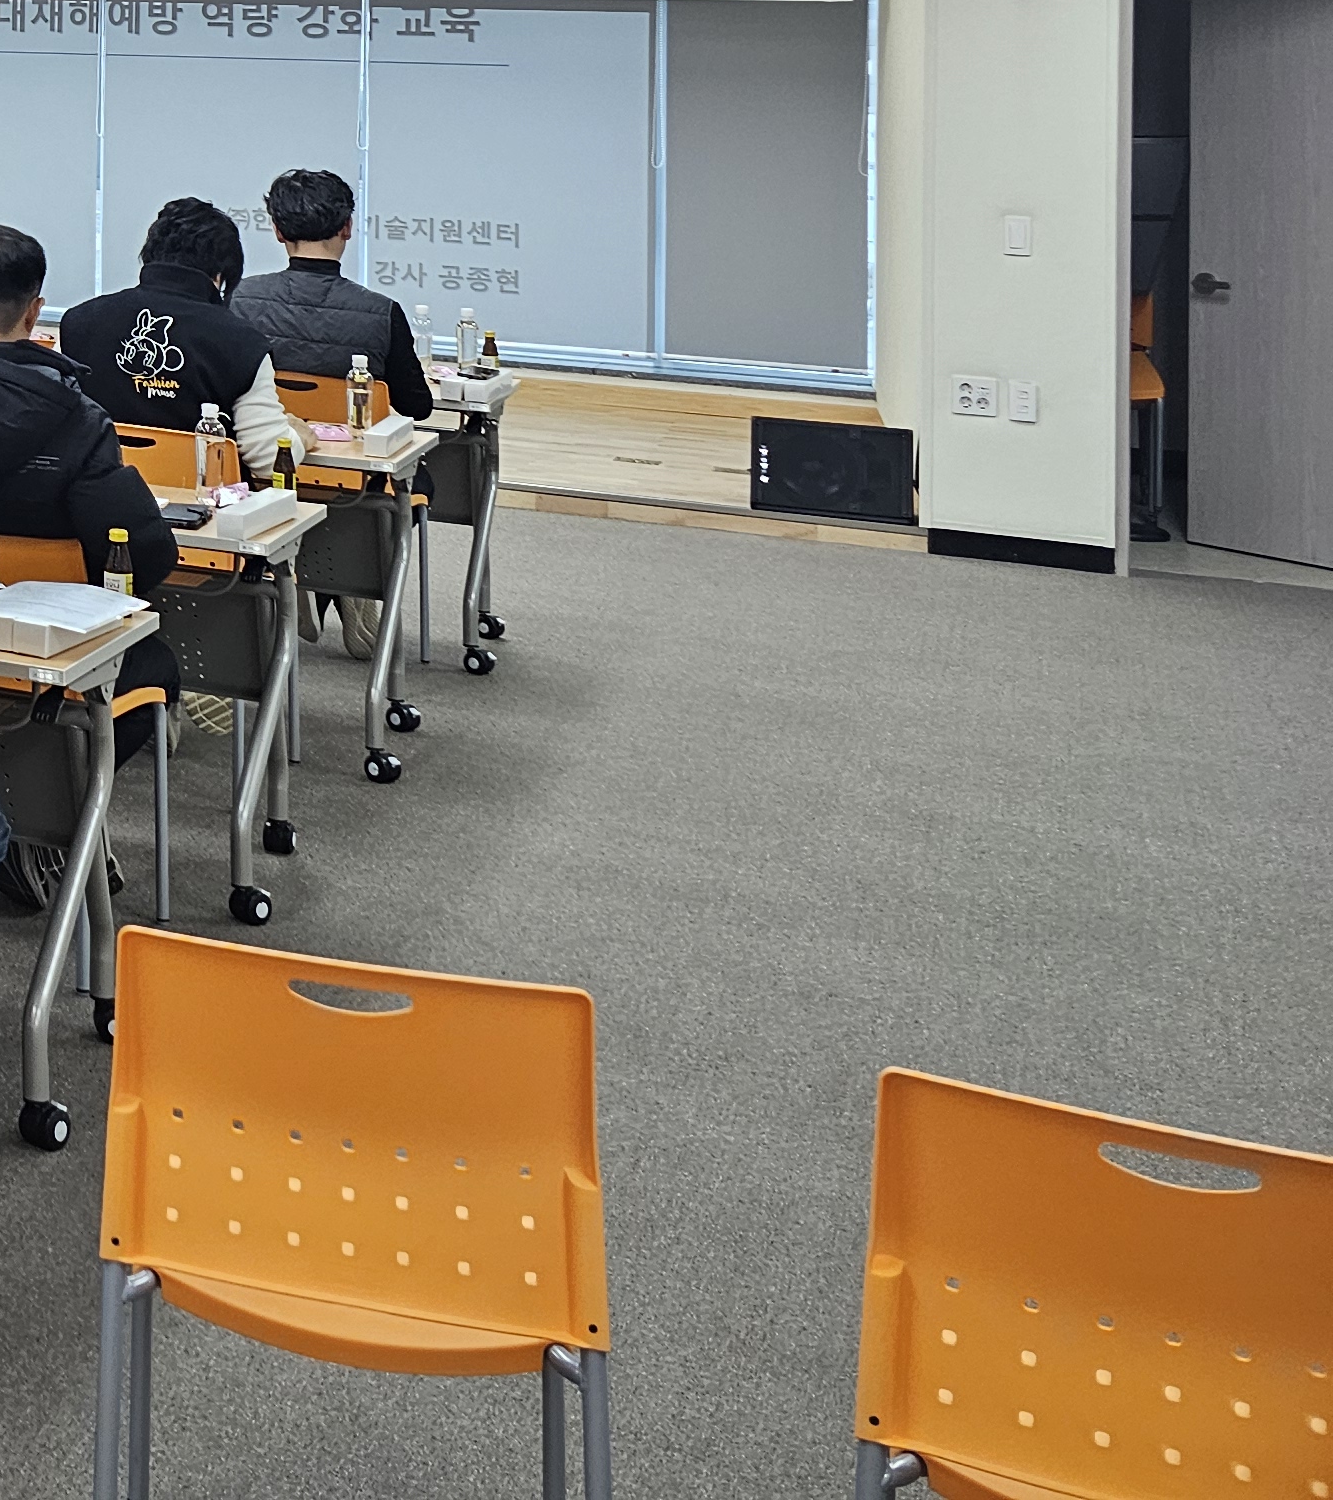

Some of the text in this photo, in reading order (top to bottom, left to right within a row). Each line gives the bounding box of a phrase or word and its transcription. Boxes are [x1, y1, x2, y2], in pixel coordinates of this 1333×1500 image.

[201, 3, 279, 39] 역량
[396, 7, 481, 43] 교육
[374, 260, 521, 296] 강사 공종현
